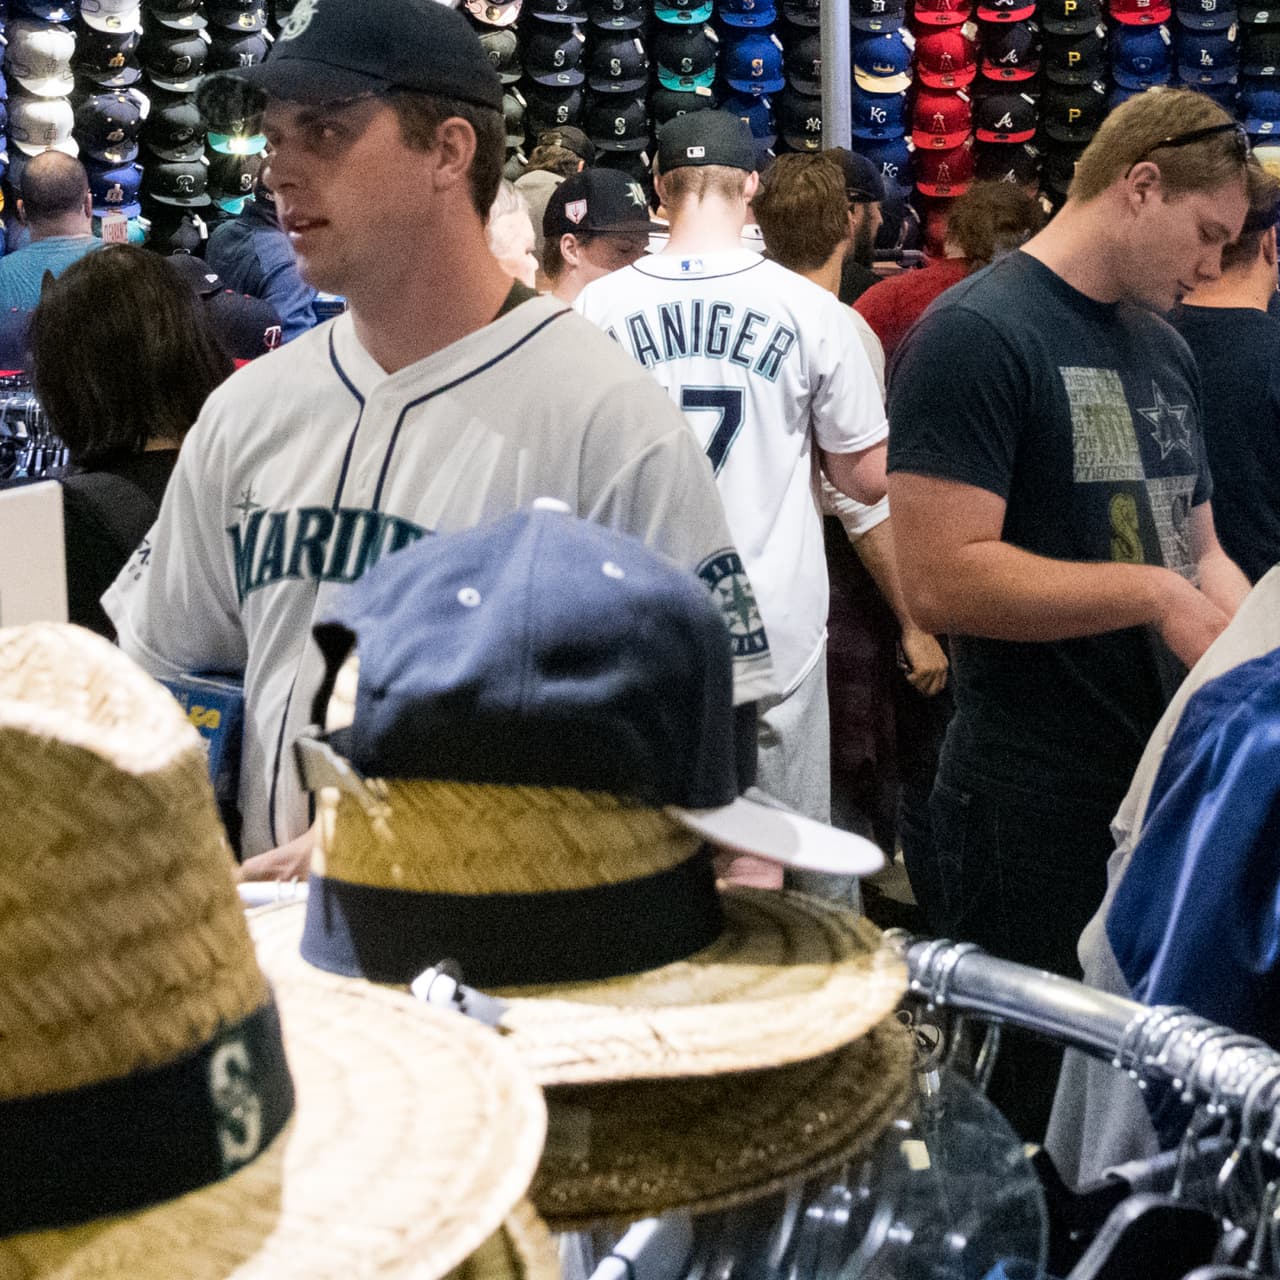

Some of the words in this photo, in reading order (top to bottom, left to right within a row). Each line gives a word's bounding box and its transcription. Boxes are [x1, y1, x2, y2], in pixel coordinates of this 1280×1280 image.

[1065, 1, 1076, 15] P
[1069, 52, 1080, 65] P
[1069, 109, 1081, 122] P
[606, 299, 798, 383] ANIGER
[664, 384, 746, 480] 7
